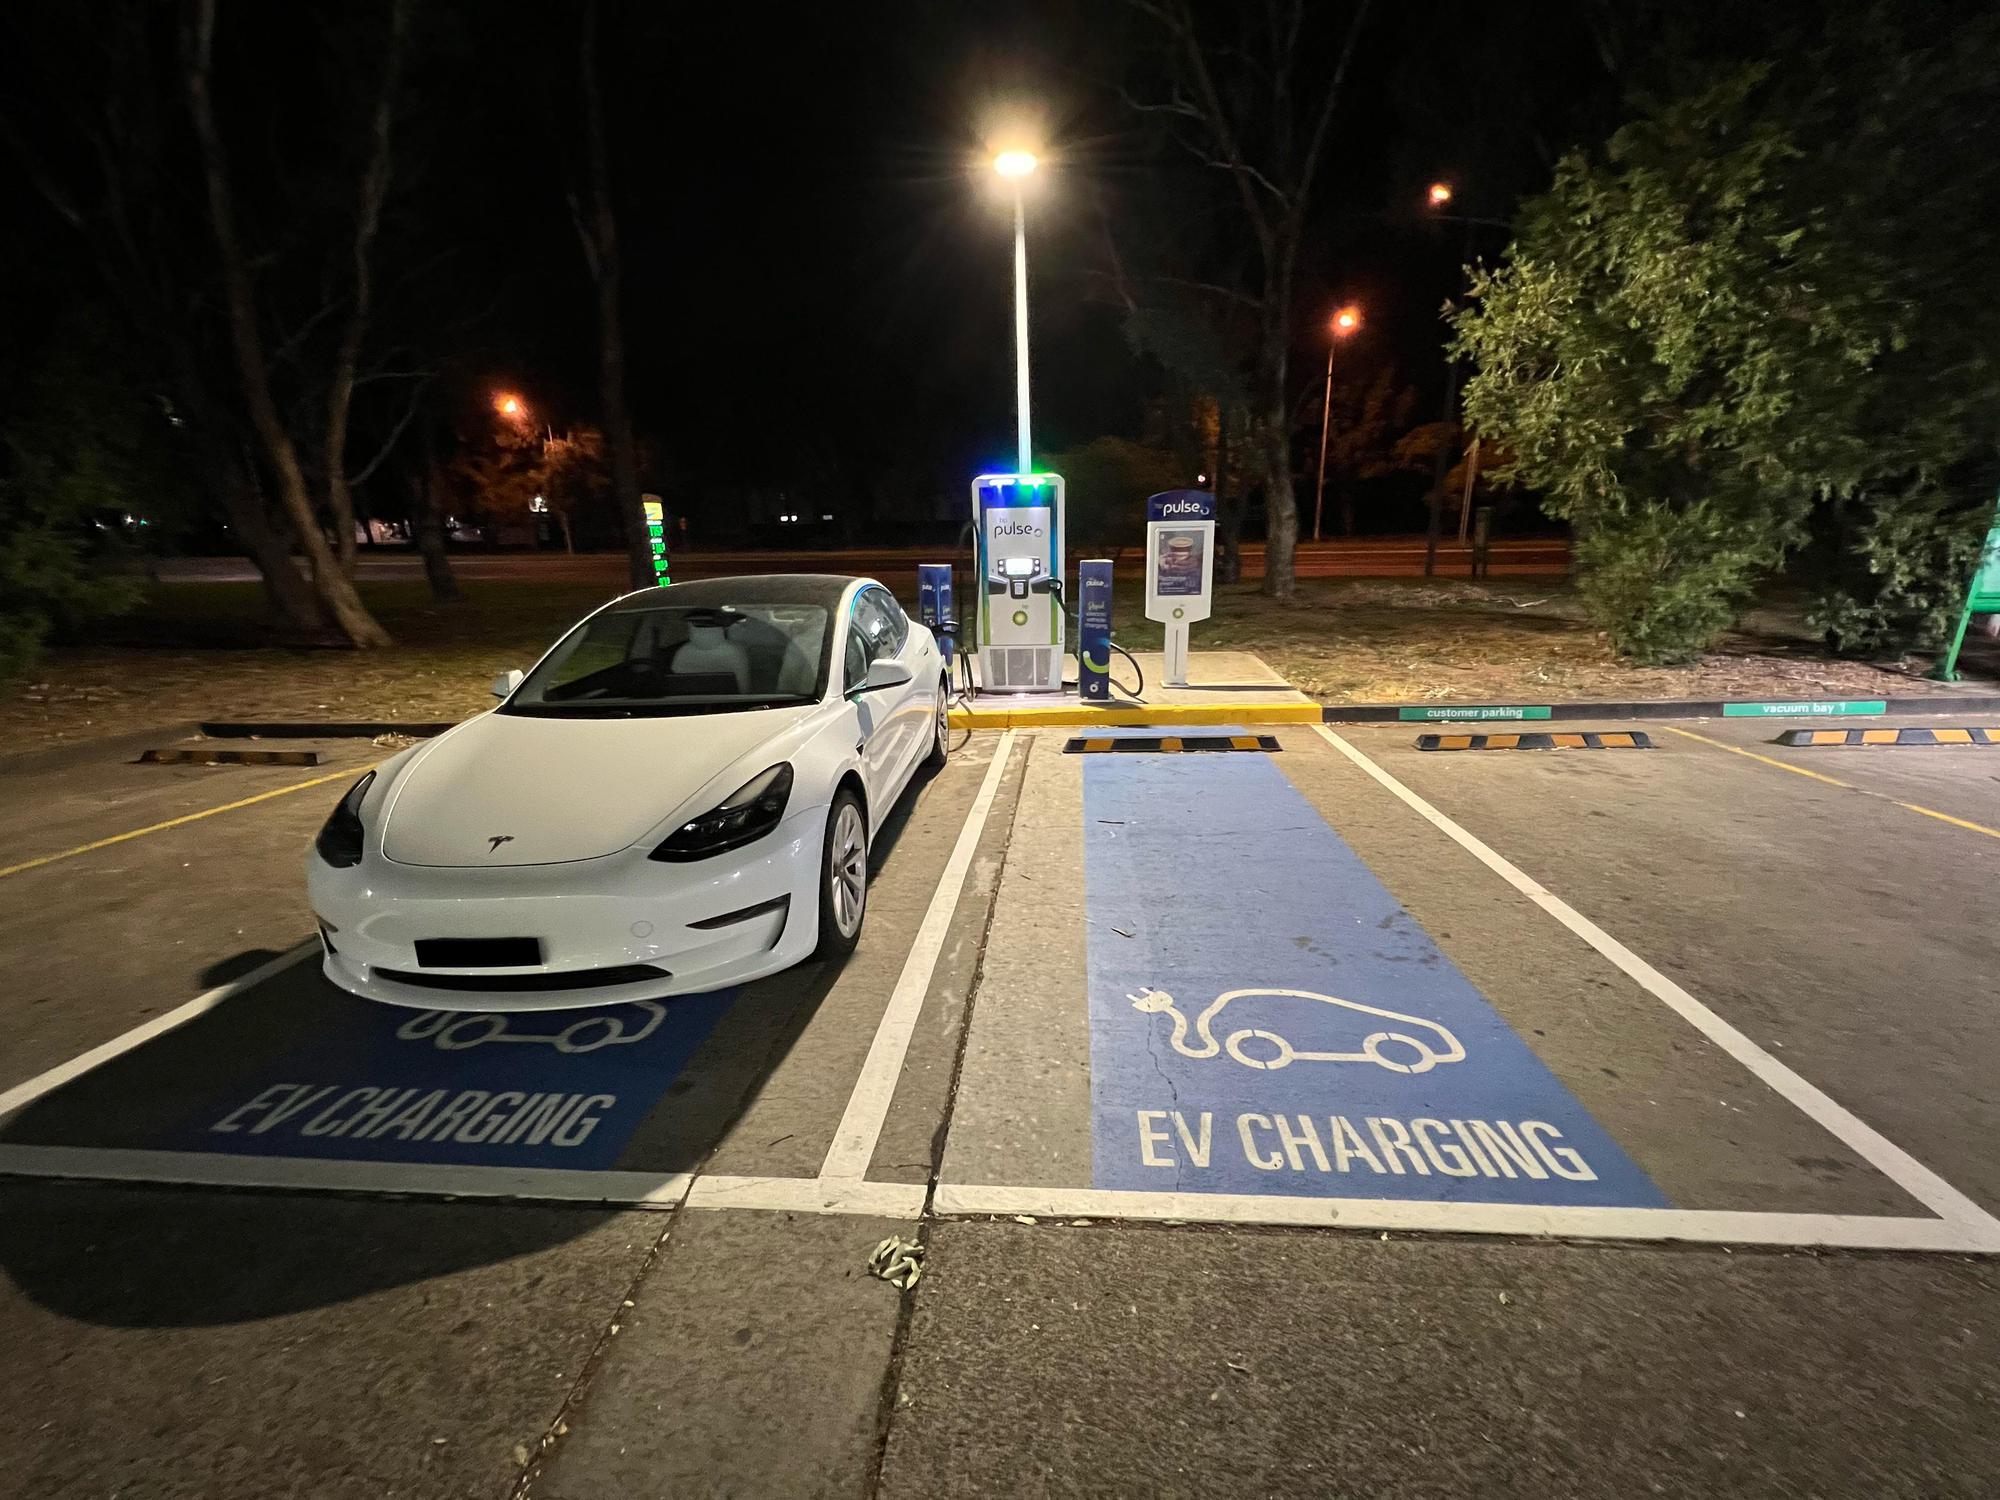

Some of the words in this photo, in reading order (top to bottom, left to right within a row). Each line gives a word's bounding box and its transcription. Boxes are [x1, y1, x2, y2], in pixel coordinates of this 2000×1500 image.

[1163, 499, 1201, 517] pulse
[994, 521, 1033, 539] pulse
[1427, 708, 1479, 717] customer
[1482, 706, 1523, 719] parking
[1763, 705, 1809, 713] vacuum
[1813, 702, 1835, 714] bay
[209, 1083, 340, 1134] EV
[301, 1086, 617, 1147] CHARGING
[1137, 1110, 1213, 1168] EV
[1236, 1113, 1598, 1181] CHARGING
